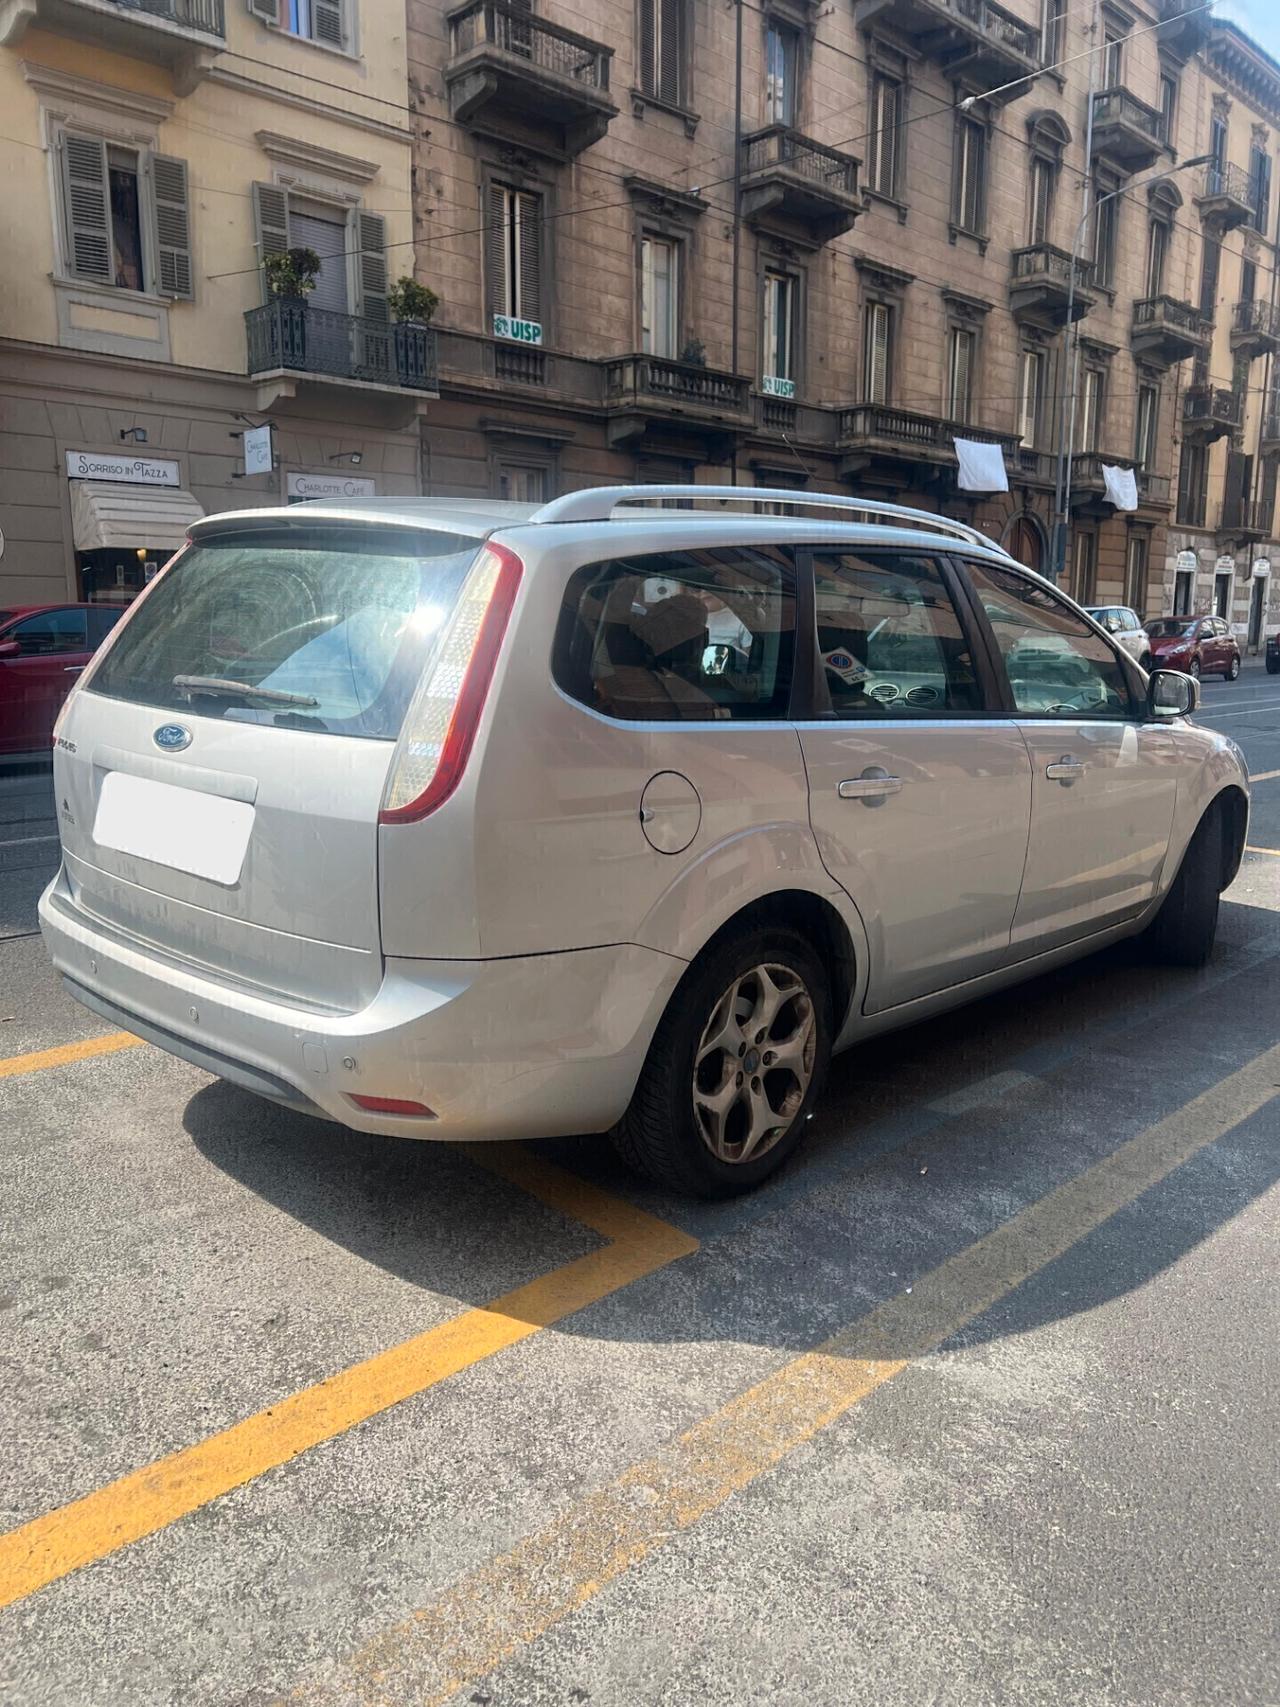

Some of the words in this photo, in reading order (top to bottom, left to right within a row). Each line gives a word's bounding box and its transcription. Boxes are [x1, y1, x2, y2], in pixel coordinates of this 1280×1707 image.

[511, 320, 541, 342] UISP
[774, 379, 795, 396] UISP
[78, 455, 123, 474] SORRISO
[125, 467, 134, 475] IN
[133, 461, 168, 479] TAZZA
[295, 477, 342, 494] CHARLOTTE
